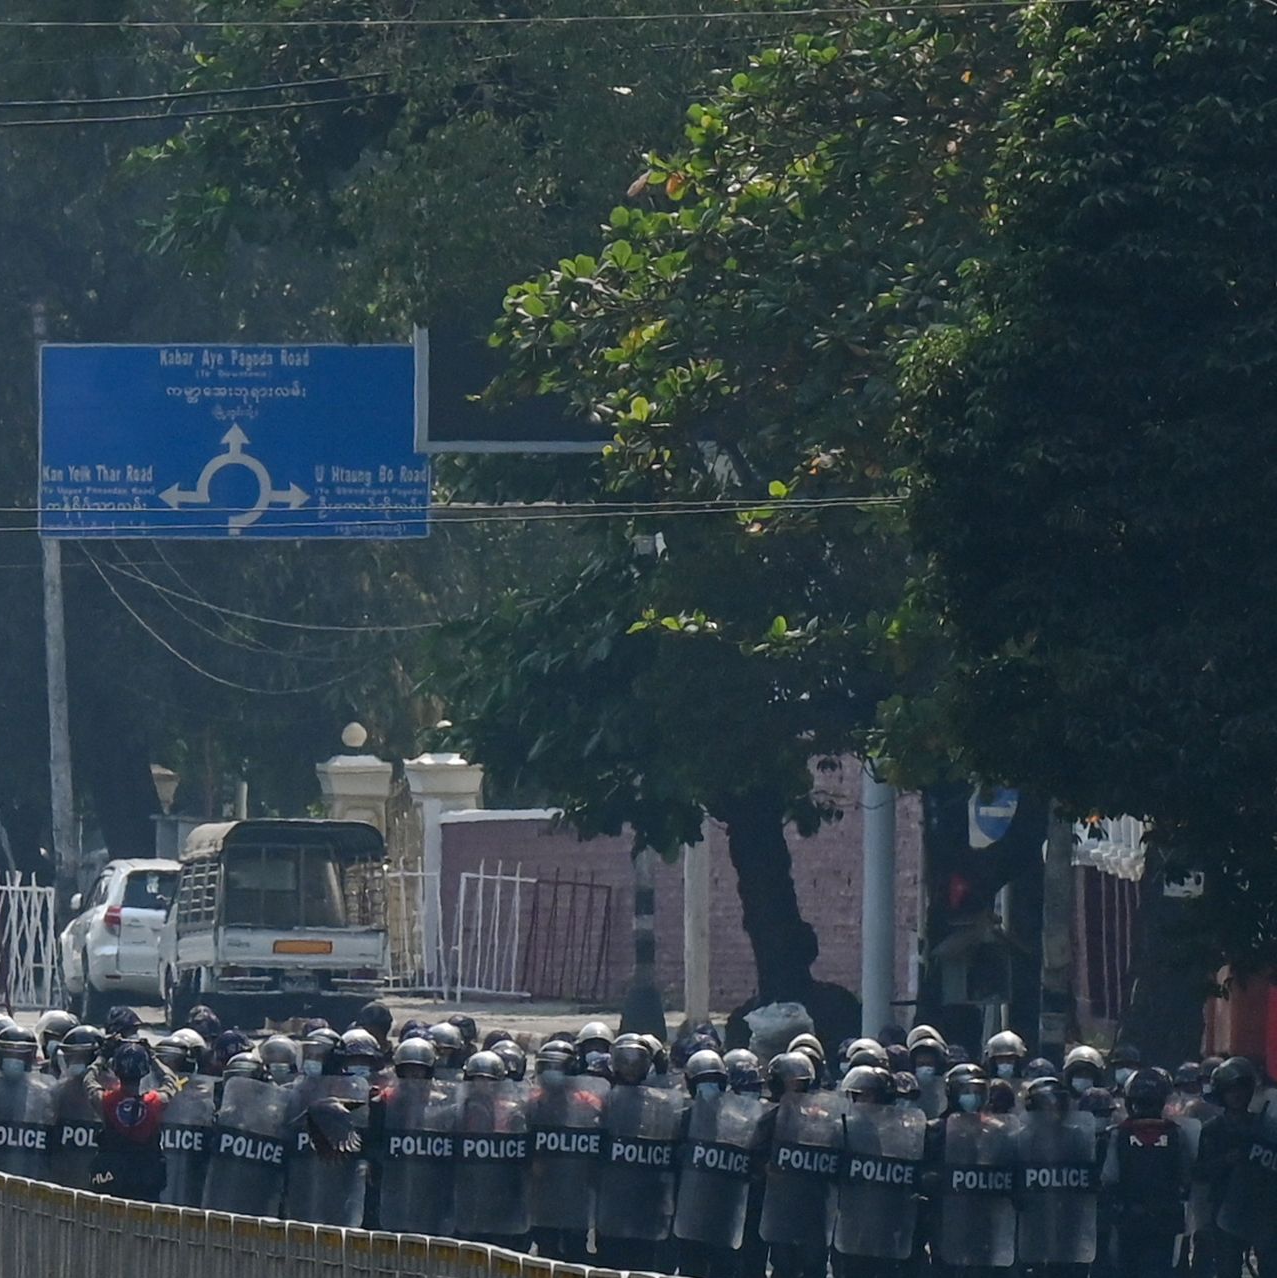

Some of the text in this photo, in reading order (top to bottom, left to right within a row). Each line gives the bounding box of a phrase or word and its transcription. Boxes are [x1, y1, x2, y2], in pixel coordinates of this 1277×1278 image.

[159, 349, 310, 371] Kabar Aye Pagoda Road
[42, 464, 64, 482] Kan
[95, 464, 122, 482] Thar
[126, 464, 153, 482] Road
[315, 465, 325, 482] U
[379, 464, 394, 482] Bo
[400, 465, 427, 482] Road
[61, 1126, 99, 1147] POL
[160, 1128, 204, 1151] LICE
[390, 1136, 453, 1157] POLICE
[535, 1132, 600, 1153] POLICE
[219, 1133, 284, 1164] POLICE
[463, 1139, 526, 1158] POLICE
[611, 1142, 671, 1165] POLICE
[693, 1145, 749, 1173] POLICE
[777, 1147, 839, 1174] POLICE
[849, 1159, 914, 1184] POLICE
[952, 1170, 1013, 1190] POLICE
[1025, 1168, 1089, 1188] POLICE
